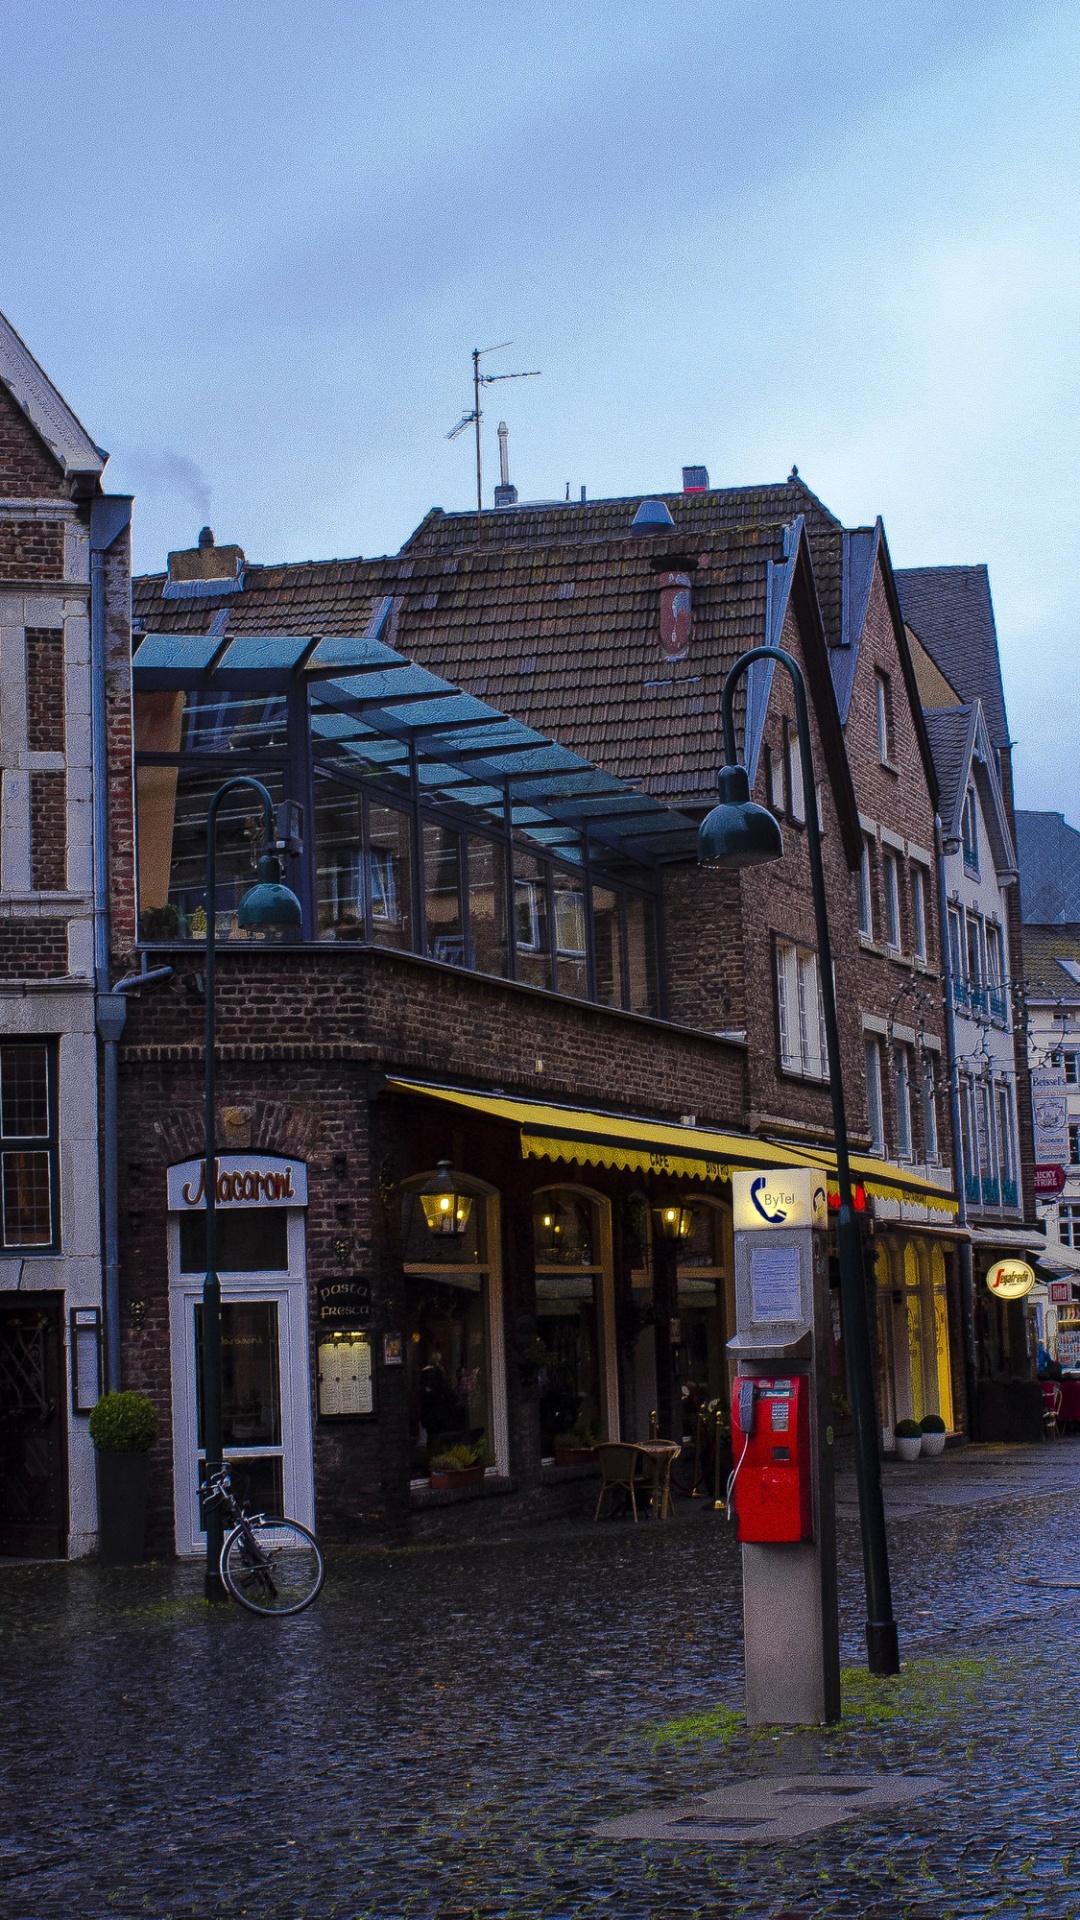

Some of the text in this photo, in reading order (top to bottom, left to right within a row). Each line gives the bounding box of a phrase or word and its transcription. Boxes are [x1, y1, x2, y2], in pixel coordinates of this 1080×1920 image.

[182, 1157, 295, 1205] Macaroni
[765, 1192, 795, 1209] ByTel
[993, 1268, 1028, 1288] Segafredo
[320, 1283, 368, 1301] pasta
[320, 1305, 370, 1319] fresca
